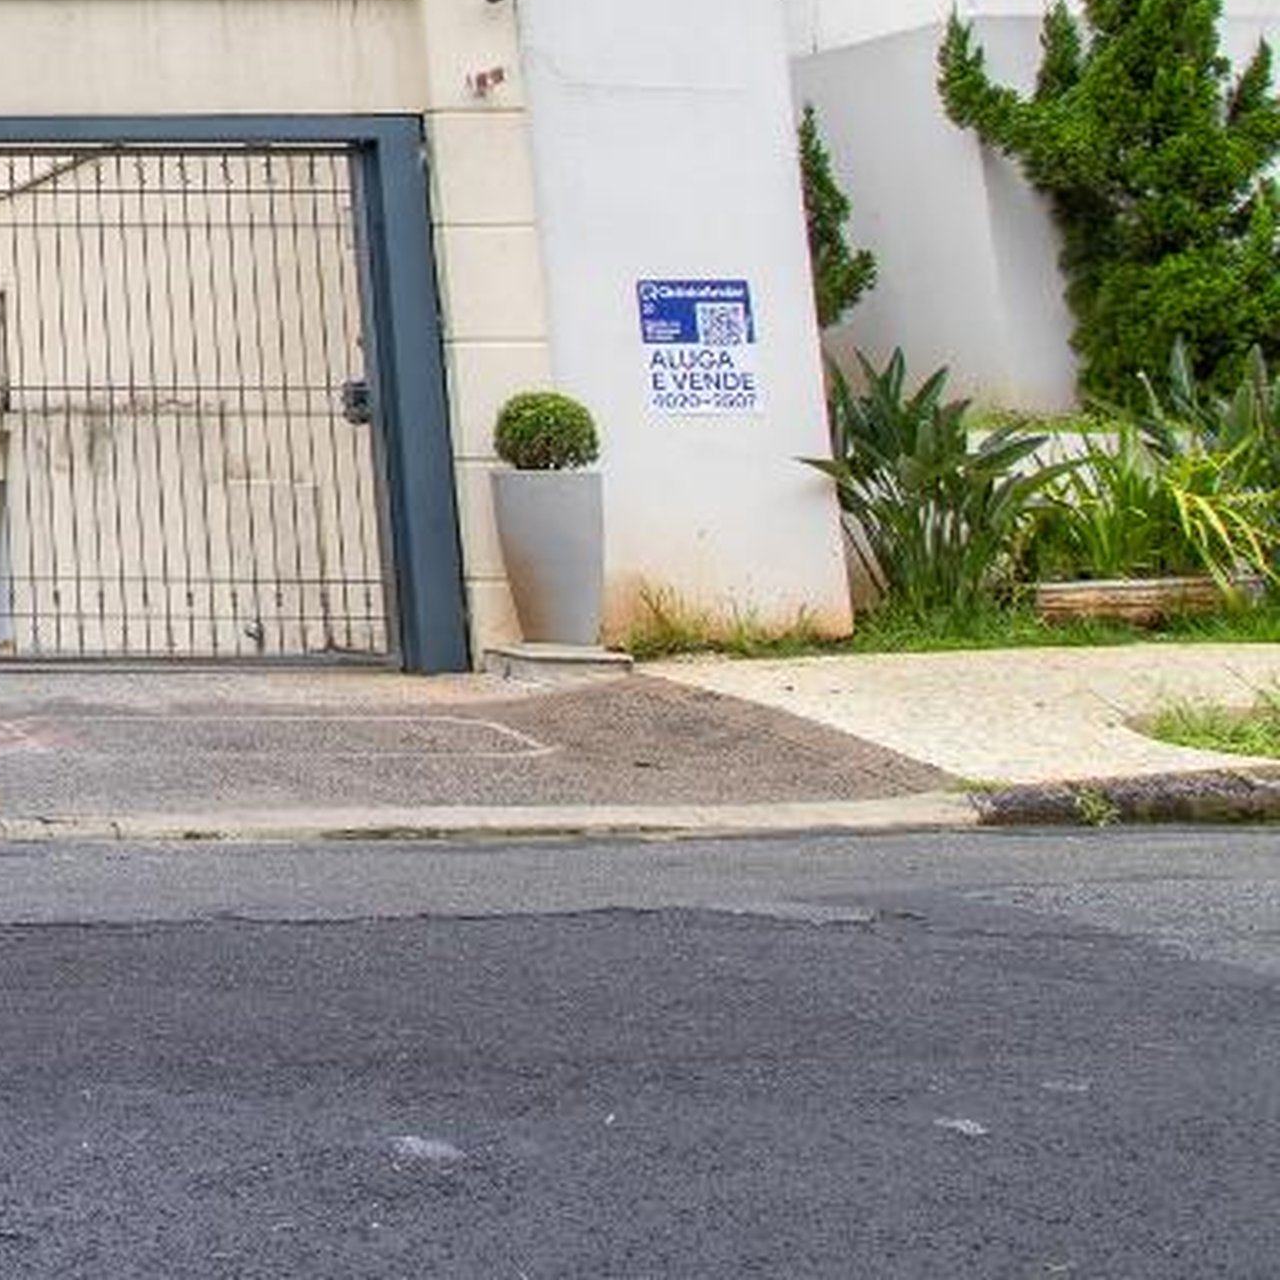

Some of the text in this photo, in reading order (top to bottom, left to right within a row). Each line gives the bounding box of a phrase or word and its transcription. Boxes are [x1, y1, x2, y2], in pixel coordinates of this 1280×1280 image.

[650, 349, 734, 370] ALUGA
[652, 372, 755, 391] E VENDE
